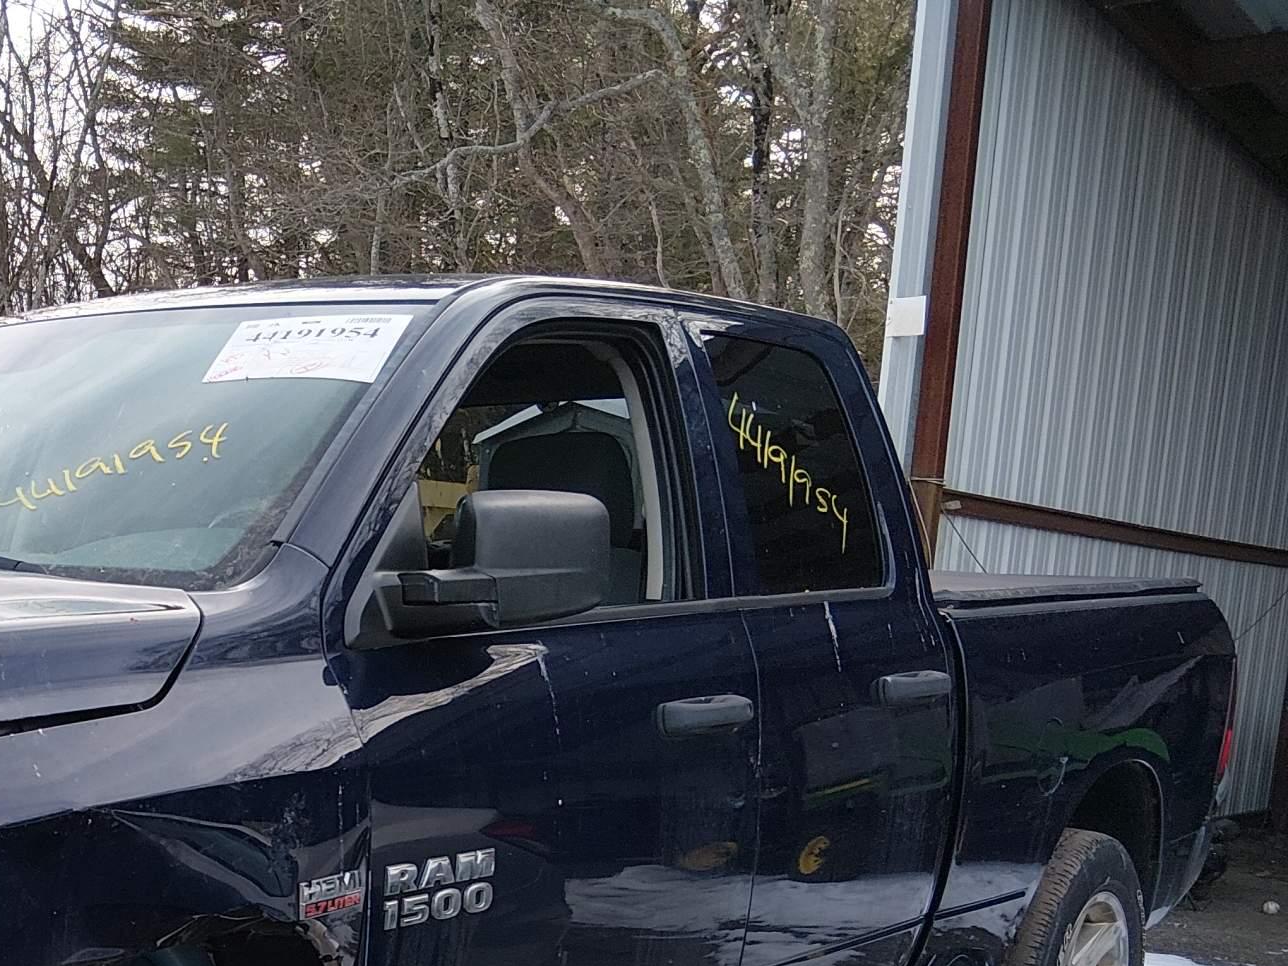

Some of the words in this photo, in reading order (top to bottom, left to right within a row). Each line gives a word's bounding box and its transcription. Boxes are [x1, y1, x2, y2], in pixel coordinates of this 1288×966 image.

[245, 327, 381, 343] 44191954
[728, 391, 848, 555] 44191954
[384, 847, 496, 897] RAM
[383, 881, 494, 931] 1500
